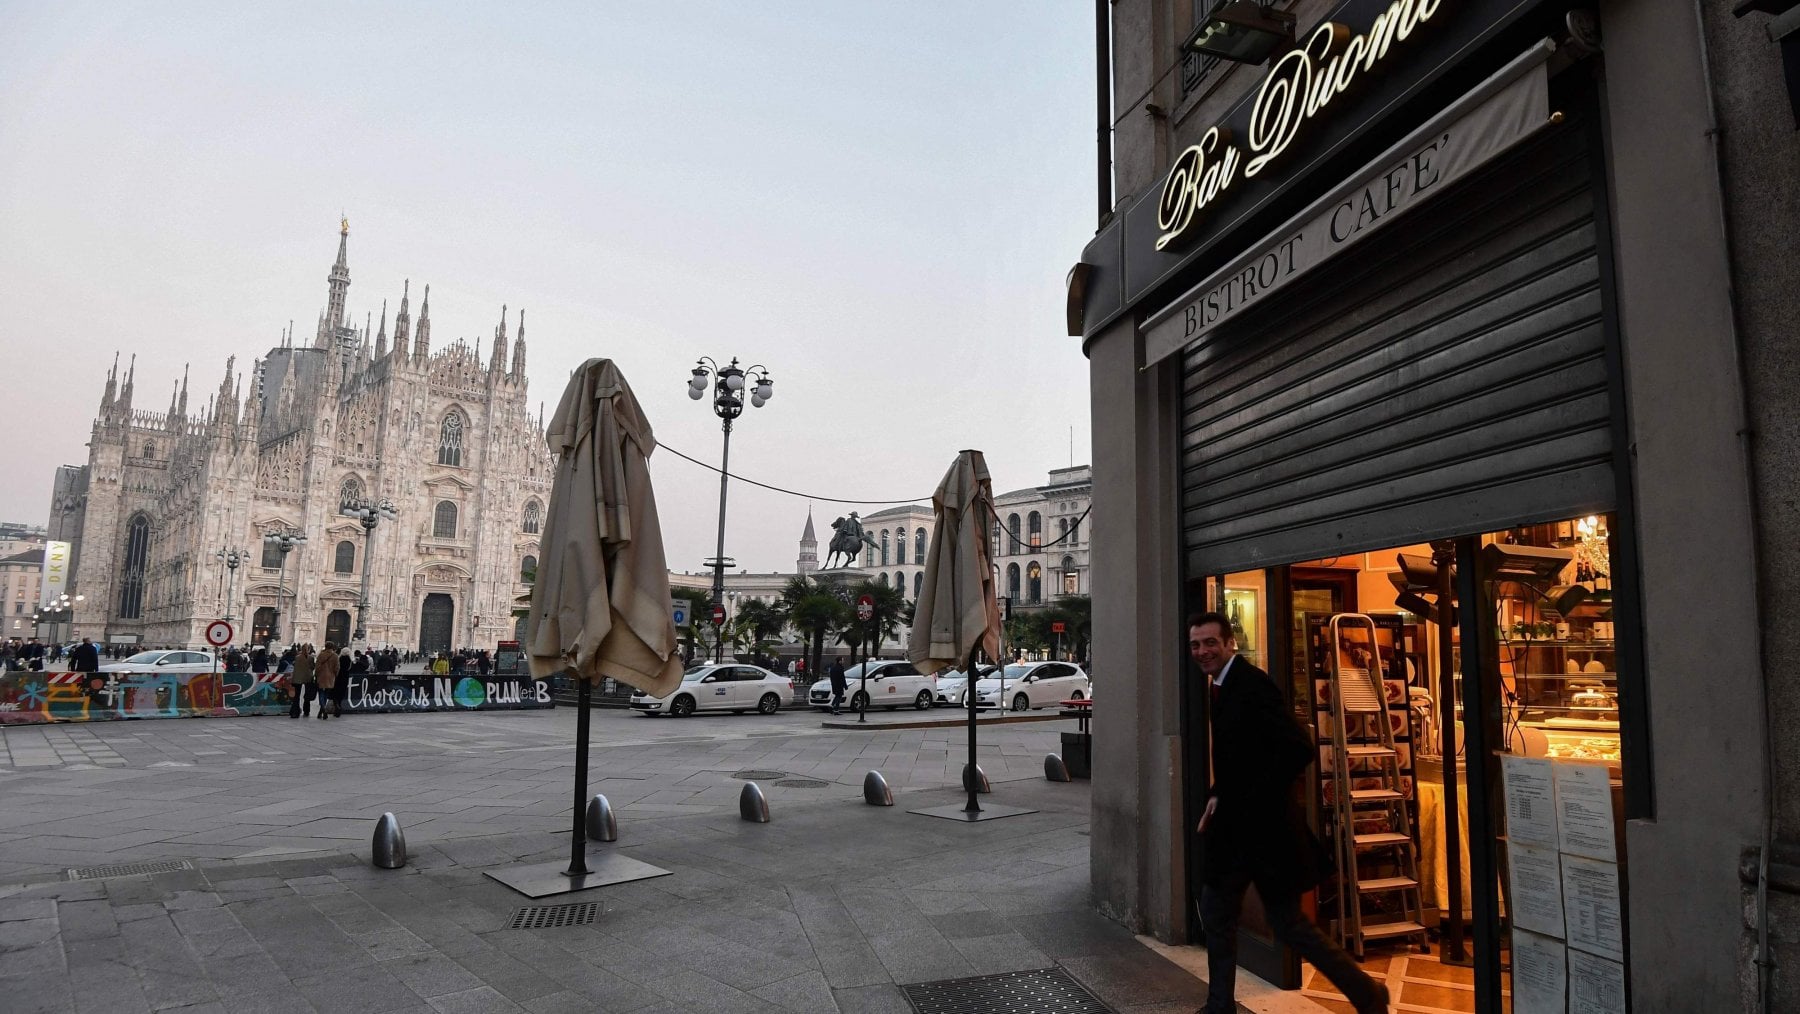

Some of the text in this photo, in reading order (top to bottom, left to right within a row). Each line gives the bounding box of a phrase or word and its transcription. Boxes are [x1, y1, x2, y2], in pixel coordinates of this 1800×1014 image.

[1156, 126, 1241, 251] Bar
[1183, 233, 1303, 339] BISTROT
[48, 542, 65, 583] DKNY
[347, 677, 407, 708] there
[409, 679, 430, 707] is
